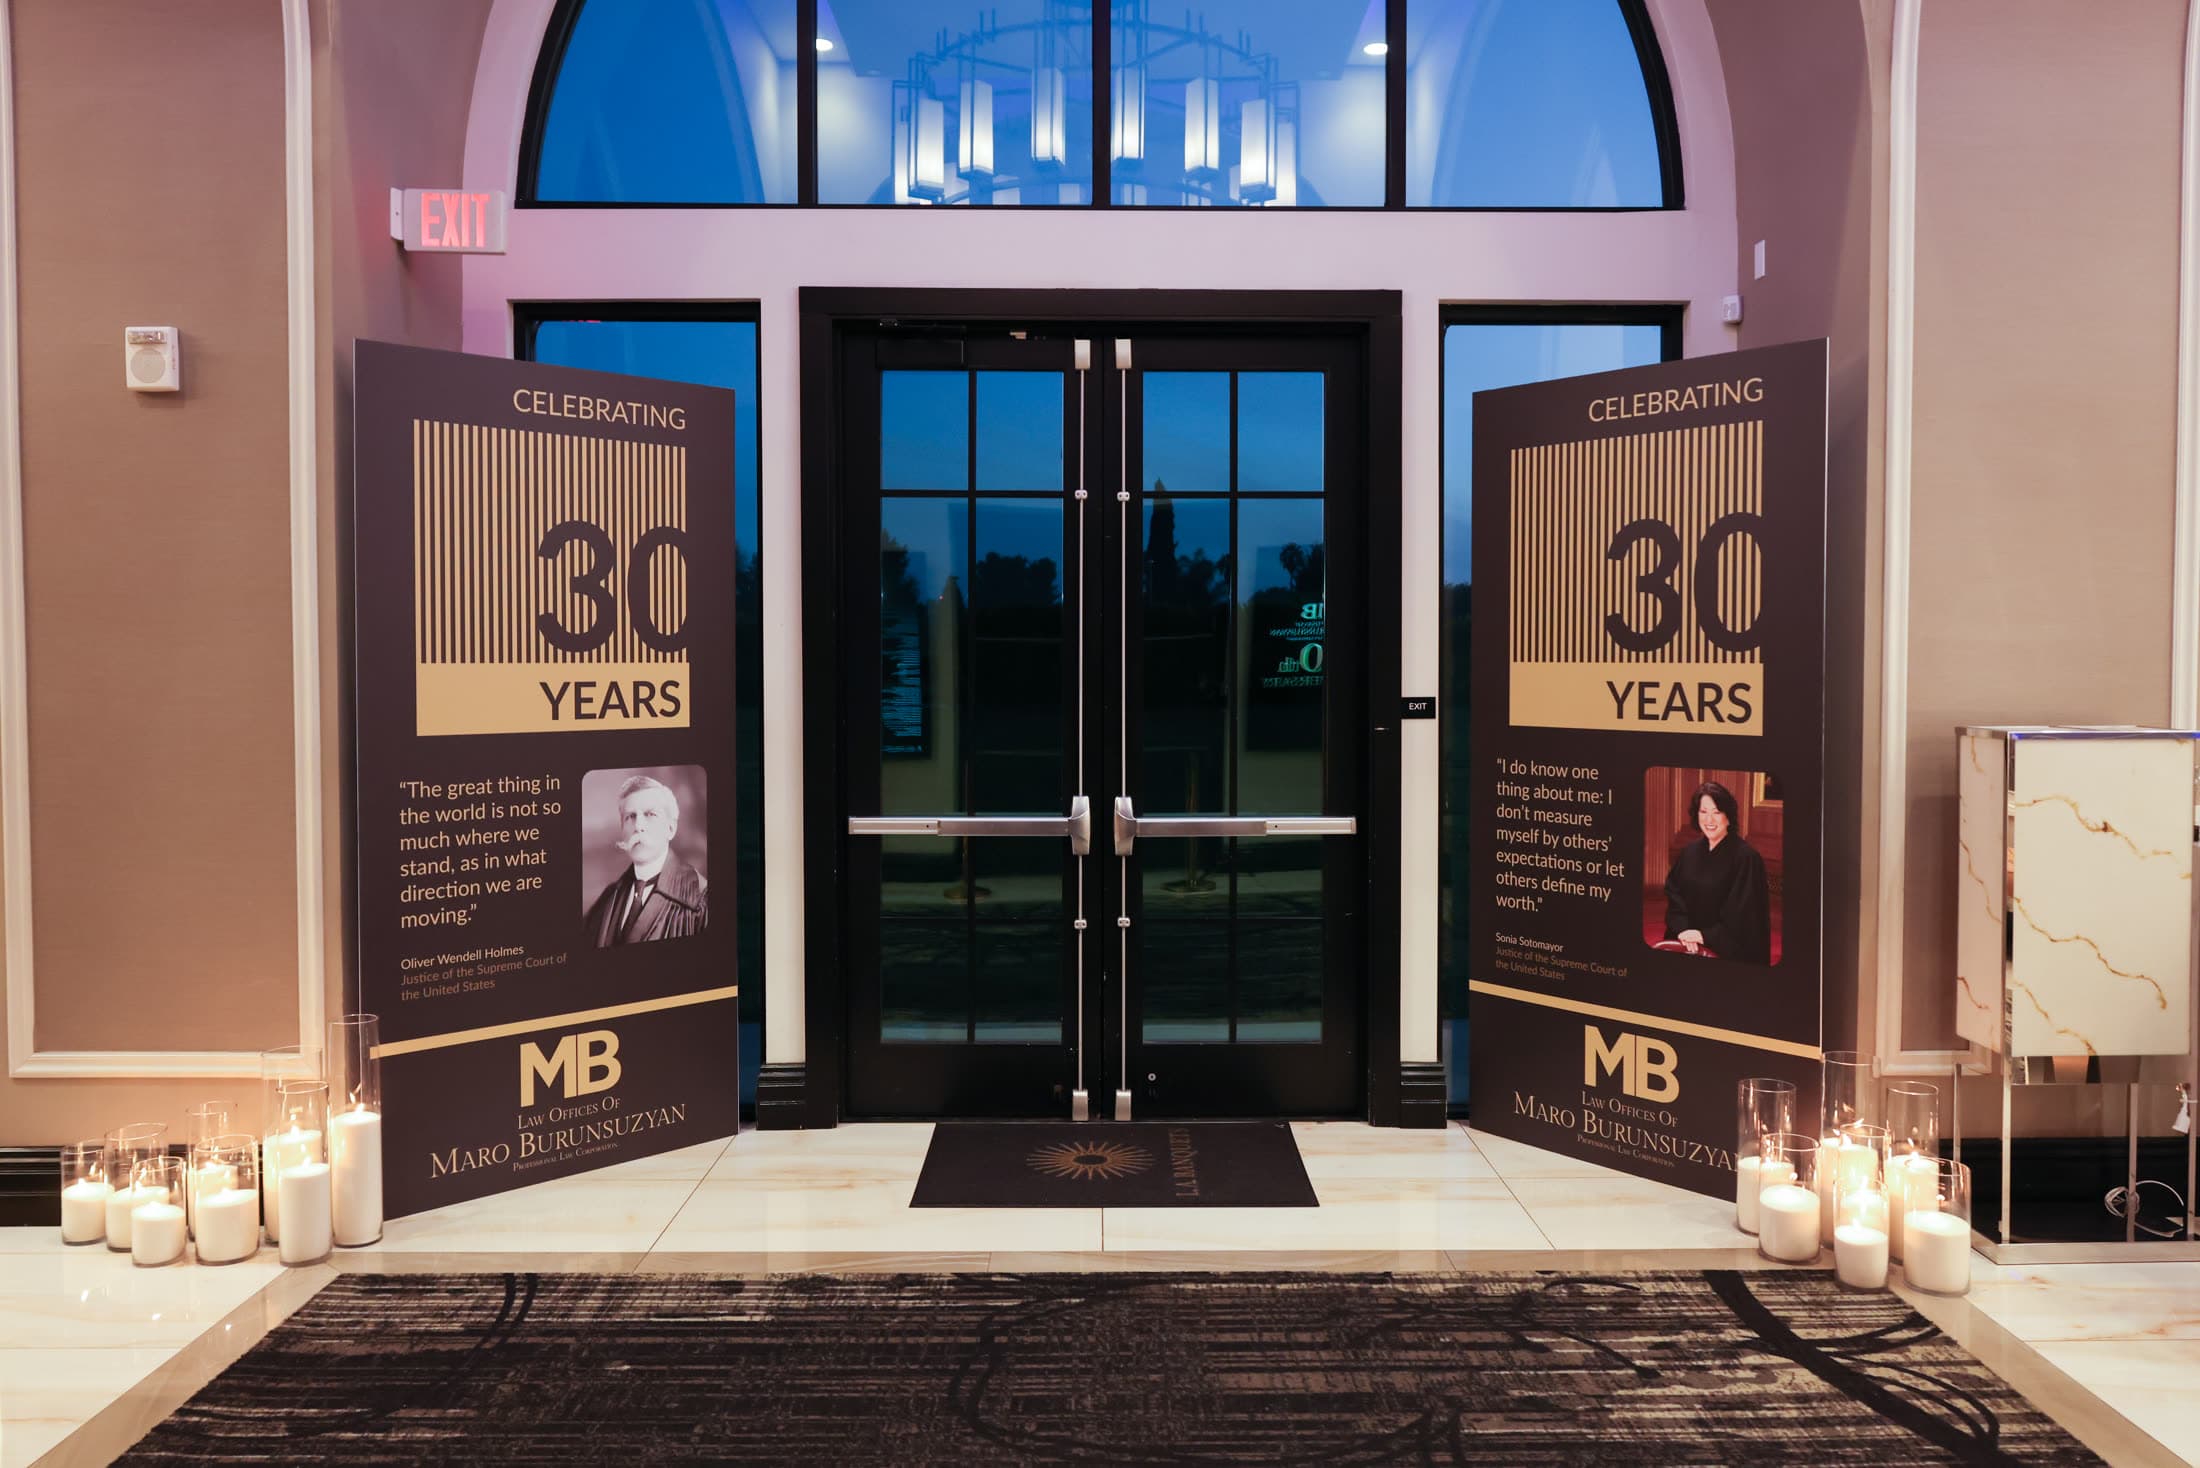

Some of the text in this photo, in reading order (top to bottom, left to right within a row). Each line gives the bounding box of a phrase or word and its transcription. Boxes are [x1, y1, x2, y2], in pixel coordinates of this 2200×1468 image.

[421, 192, 491, 248] EXIT
[513, 388, 686, 431] CELEBRATING
[1588, 377, 1763, 423] CELEBRATING
[536, 520, 687, 654] 30
[1604, 511, 1763, 653] 30
[538, 680, 681, 721] YEARS
[1408, 702, 1428, 710] EXIT
[1606, 680, 1753, 724] YEARS
[1510, 759, 1527, 775] do
[1530, 760, 1569, 778] know
[1571, 767, 1599, 780] one
[447, 779, 493, 800] great
[498, 776, 541, 795] thing
[545, 774, 560, 790] in
[1496, 781, 1613, 805] thing about me: I
[400, 801, 561, 825] the world is not so
[1496, 804, 1593, 827] don't measure
[400, 828, 540, 851] much where we
[1496, 827, 1612, 852] myself by others'
[400, 849, 547, 877] stand, as in what
[1496, 850, 1625, 878] expectations or let
[400, 876, 542, 903] direction we are
[1496, 871, 1612, 903] others define my
[1495, 932, 1564, 953] Sonia Sotomayor
[401, 945, 524, 970] Oliver Wendell Holmes
[401, 953, 567, 986] Justice of the Supreme Court of
[1496, 946, 1627, 977] Justice of the Supreme Court of
[1496, 960, 1565, 980] the United States
[401, 980, 496, 1001] the United States
[519, 1029, 623, 1108] MB
[1584, 1024, 1680, 1104] MB
